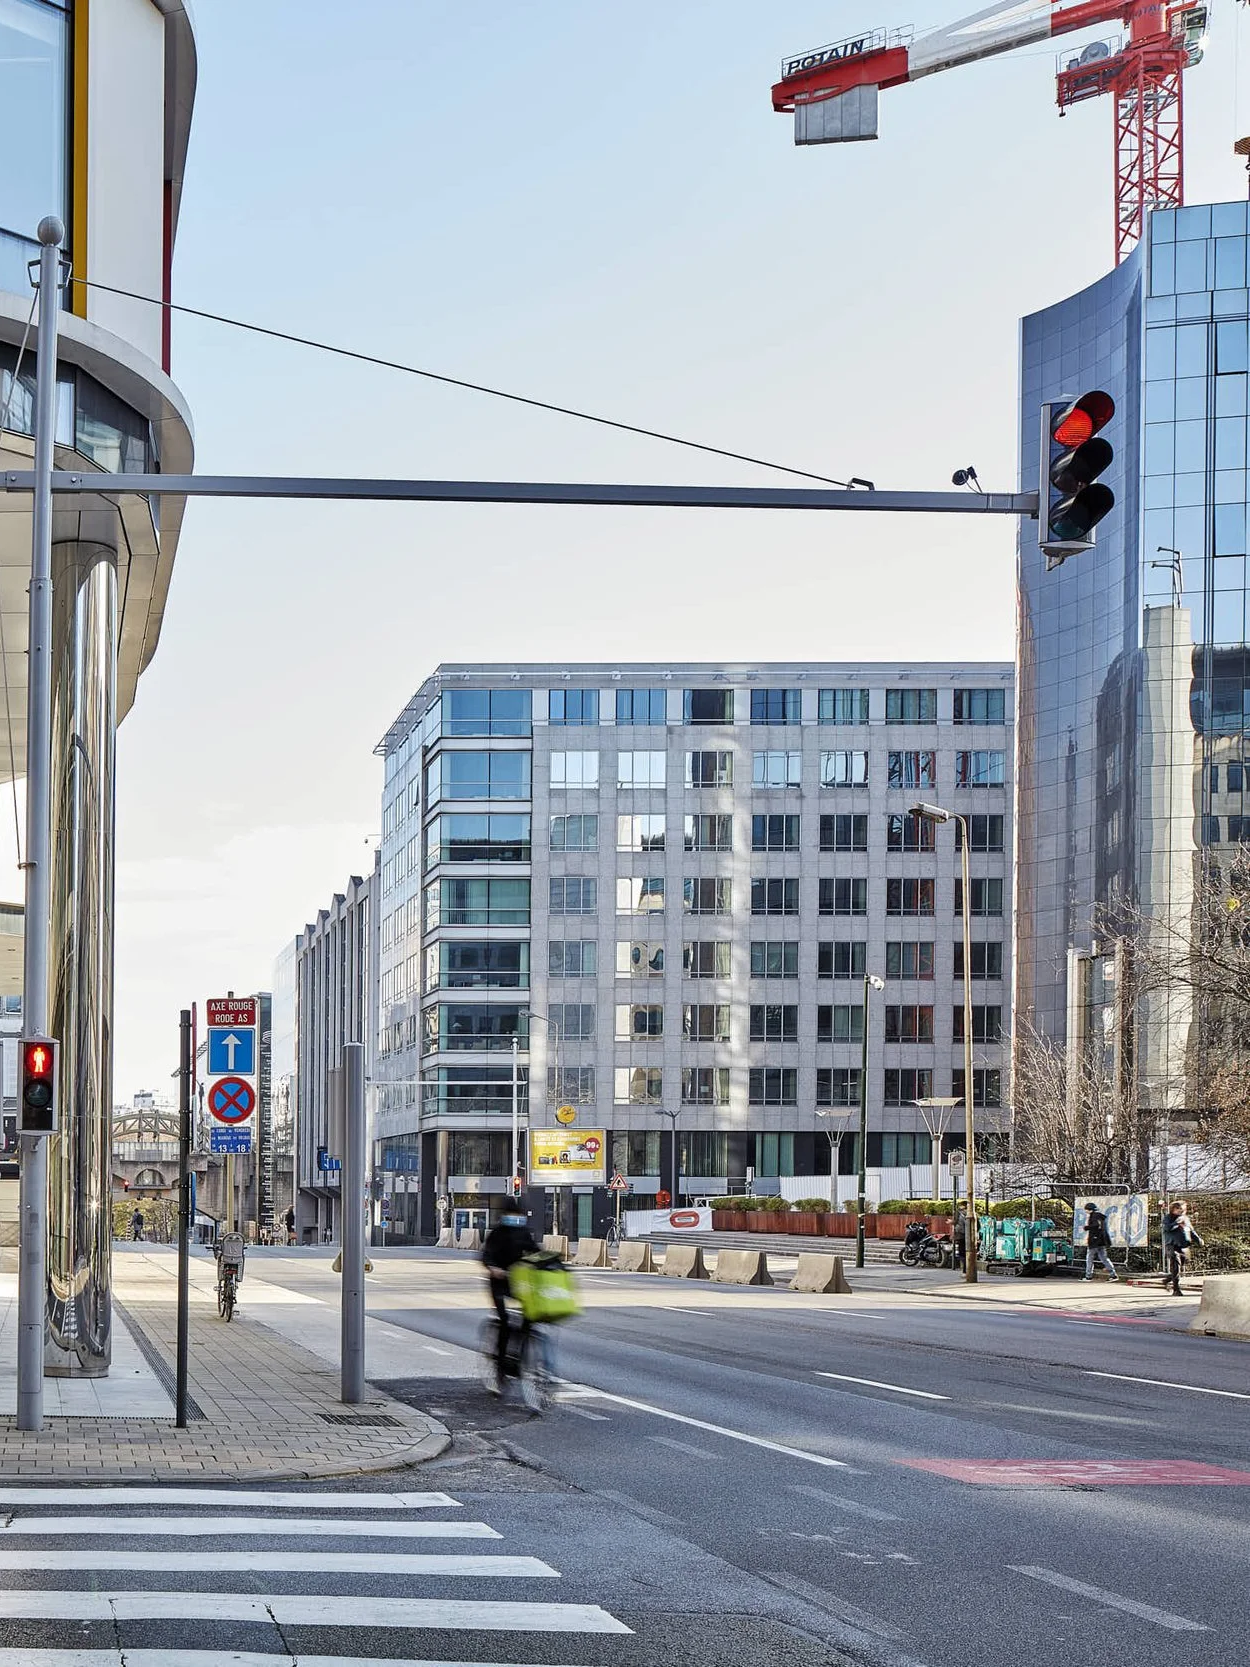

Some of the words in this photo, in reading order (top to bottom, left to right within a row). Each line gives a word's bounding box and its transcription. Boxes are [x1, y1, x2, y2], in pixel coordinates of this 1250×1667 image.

[786, 39, 867, 76] POTAIN
[210, 1001, 227, 1011] AXE
[228, 1001, 254, 1011] ROUGE
[215, 1013, 235, 1023] RODE
[238, 1013, 248, 1023] AS
[219, 1144, 228, 1153] 13
[236, 1144, 246, 1153] 18
